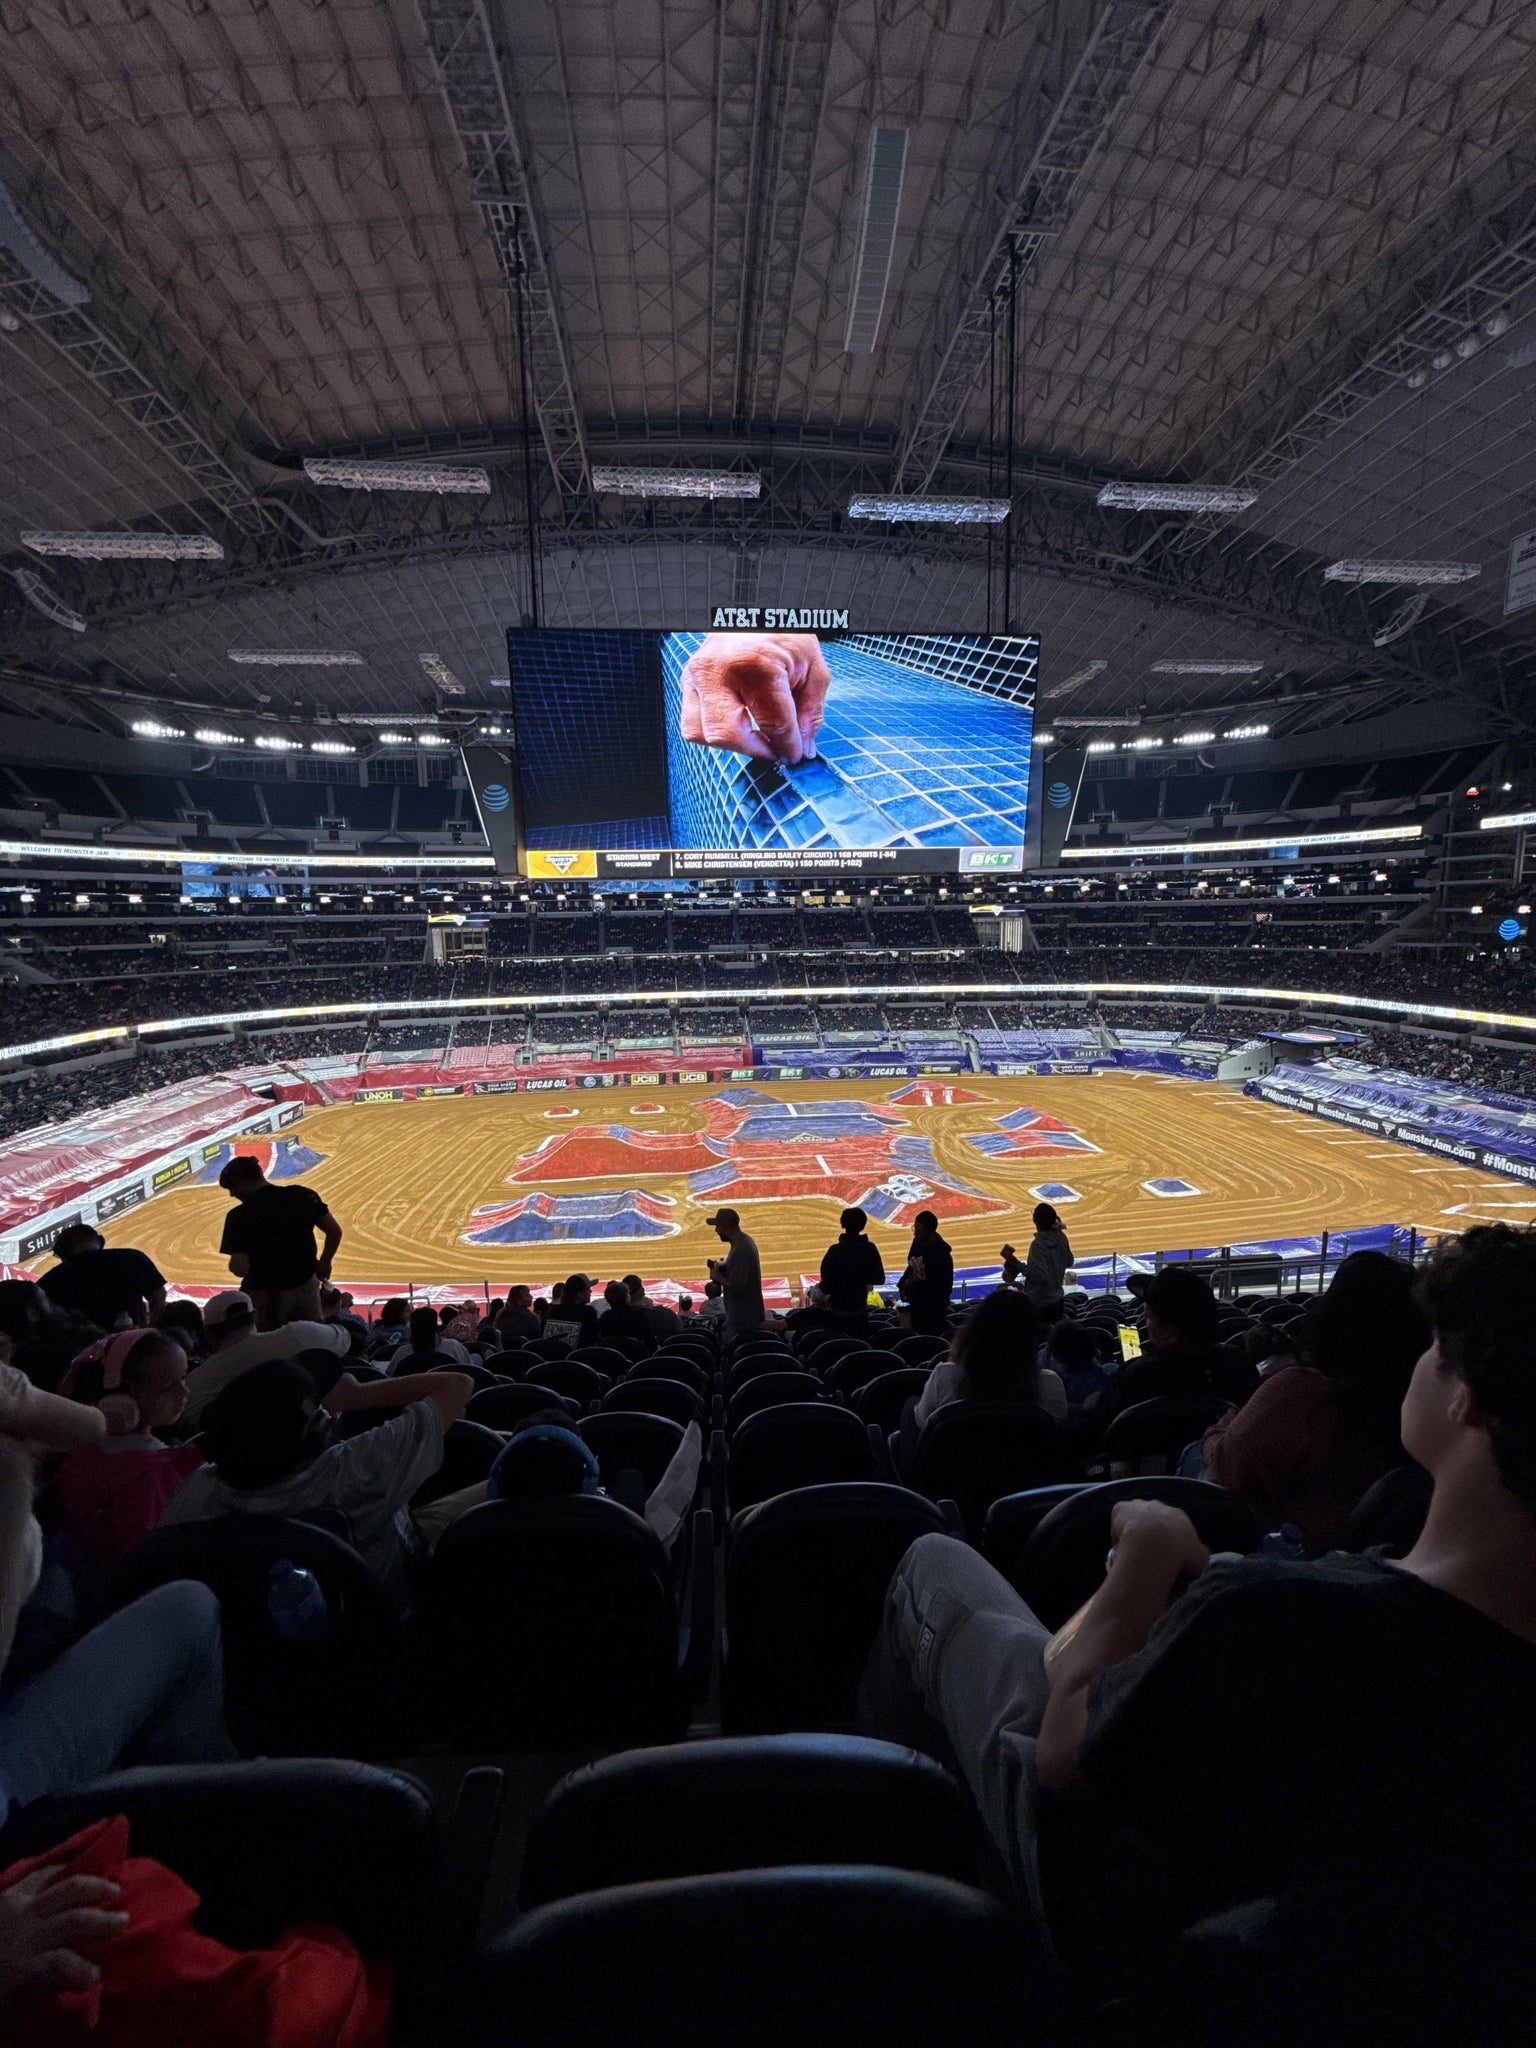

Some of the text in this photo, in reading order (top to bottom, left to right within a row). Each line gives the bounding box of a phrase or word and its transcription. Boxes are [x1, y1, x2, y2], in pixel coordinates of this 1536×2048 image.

[713, 608, 849, 628] AT&T STADIUM
[21, 845, 51, 853] WELCOME
[64, 848, 94, 856] MONSTER
[754, 860, 794, 868] (VENDETTA)
[841, 859, 862, 868] [-102]
[969, 852, 1014, 867] BKT
[1355, 999, 1380, 1007] WELCOME
[1391, 1003, 1419, 1012] MONSTER
[8, 1044, 38, 1055] MONSTER
[41, 1041, 53, 1049] JAM
[870, 1067, 908, 1076] LUCAS OIL
[526, 1079, 567, 1089] LUCAS OIL
[364, 1091, 393, 1100] UNOH
[1261, 1087, 1314, 1111] #MonsterJam
[1317, 1104, 1379, 1130] MonsterJam.com
[1397, 1128, 1476, 1160] MonsterJam.com
